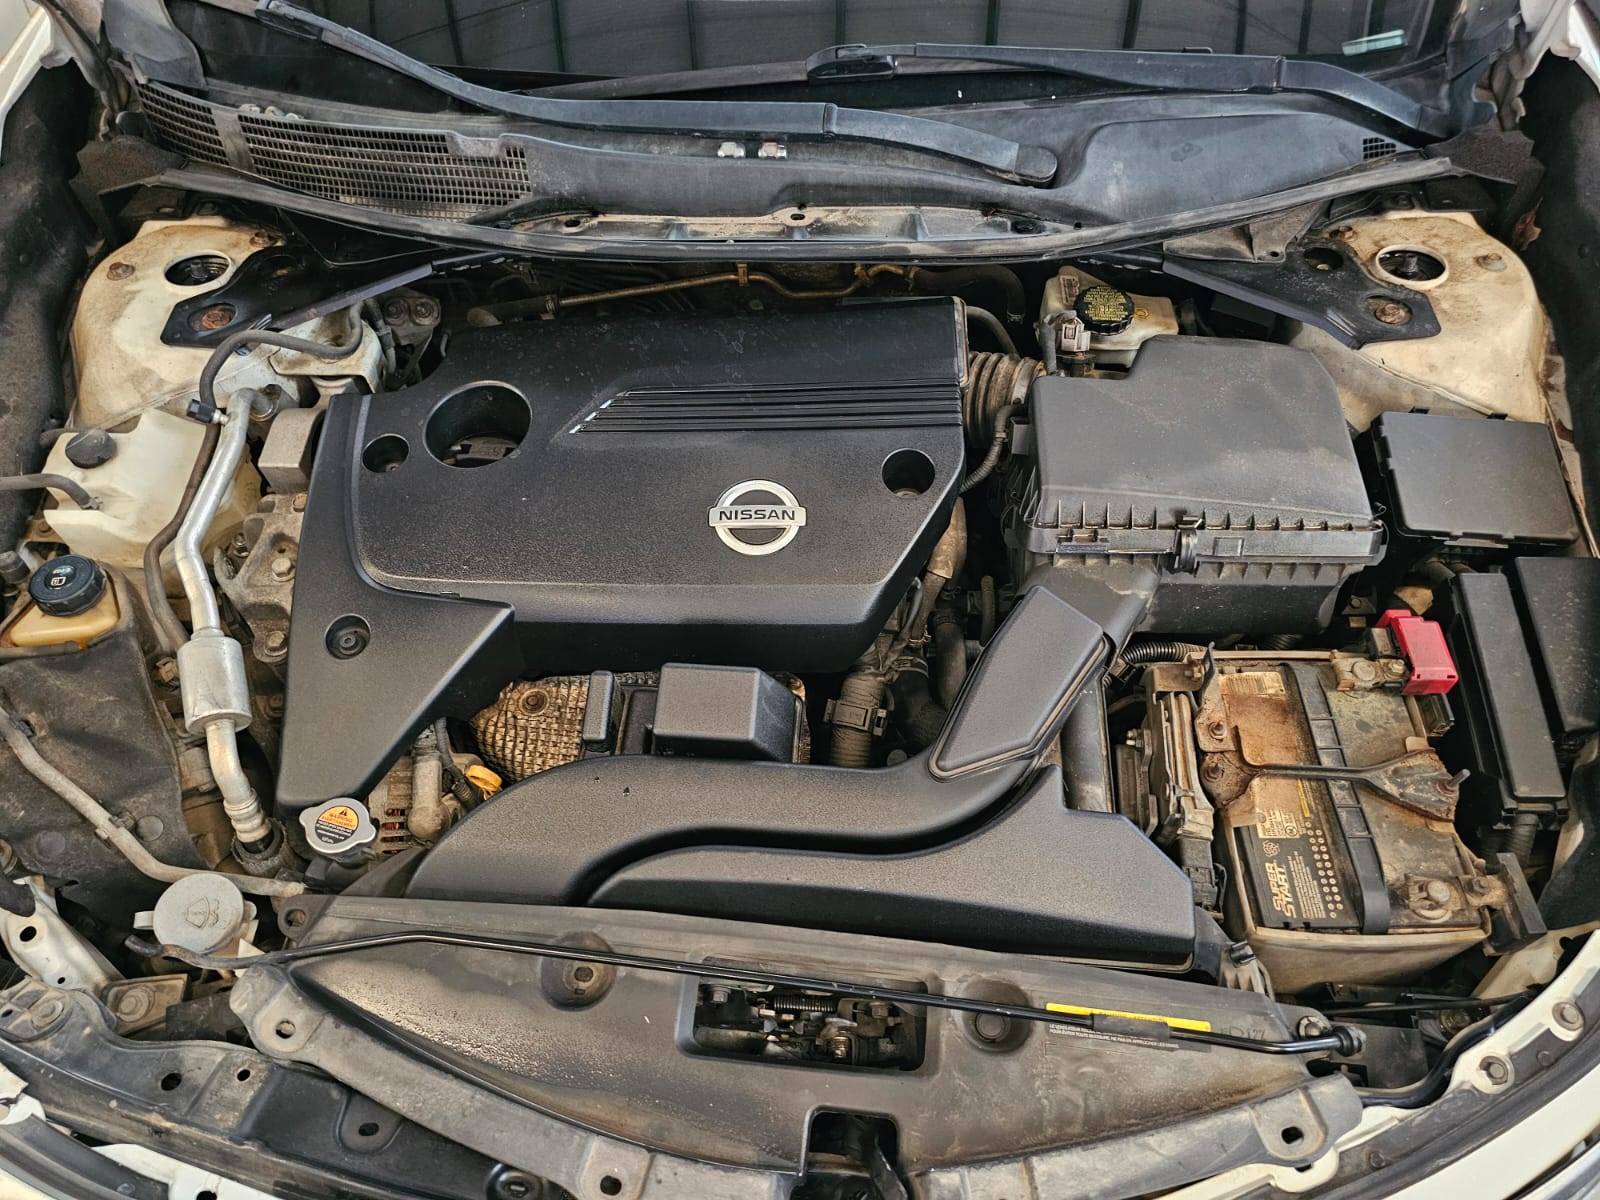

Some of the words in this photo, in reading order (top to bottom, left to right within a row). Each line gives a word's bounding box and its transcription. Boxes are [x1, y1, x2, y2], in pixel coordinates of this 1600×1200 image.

[719, 509, 795, 521] NISSAN
[1265, 862, 1281, 911] SUPER
[1275, 863, 1297, 918] START
